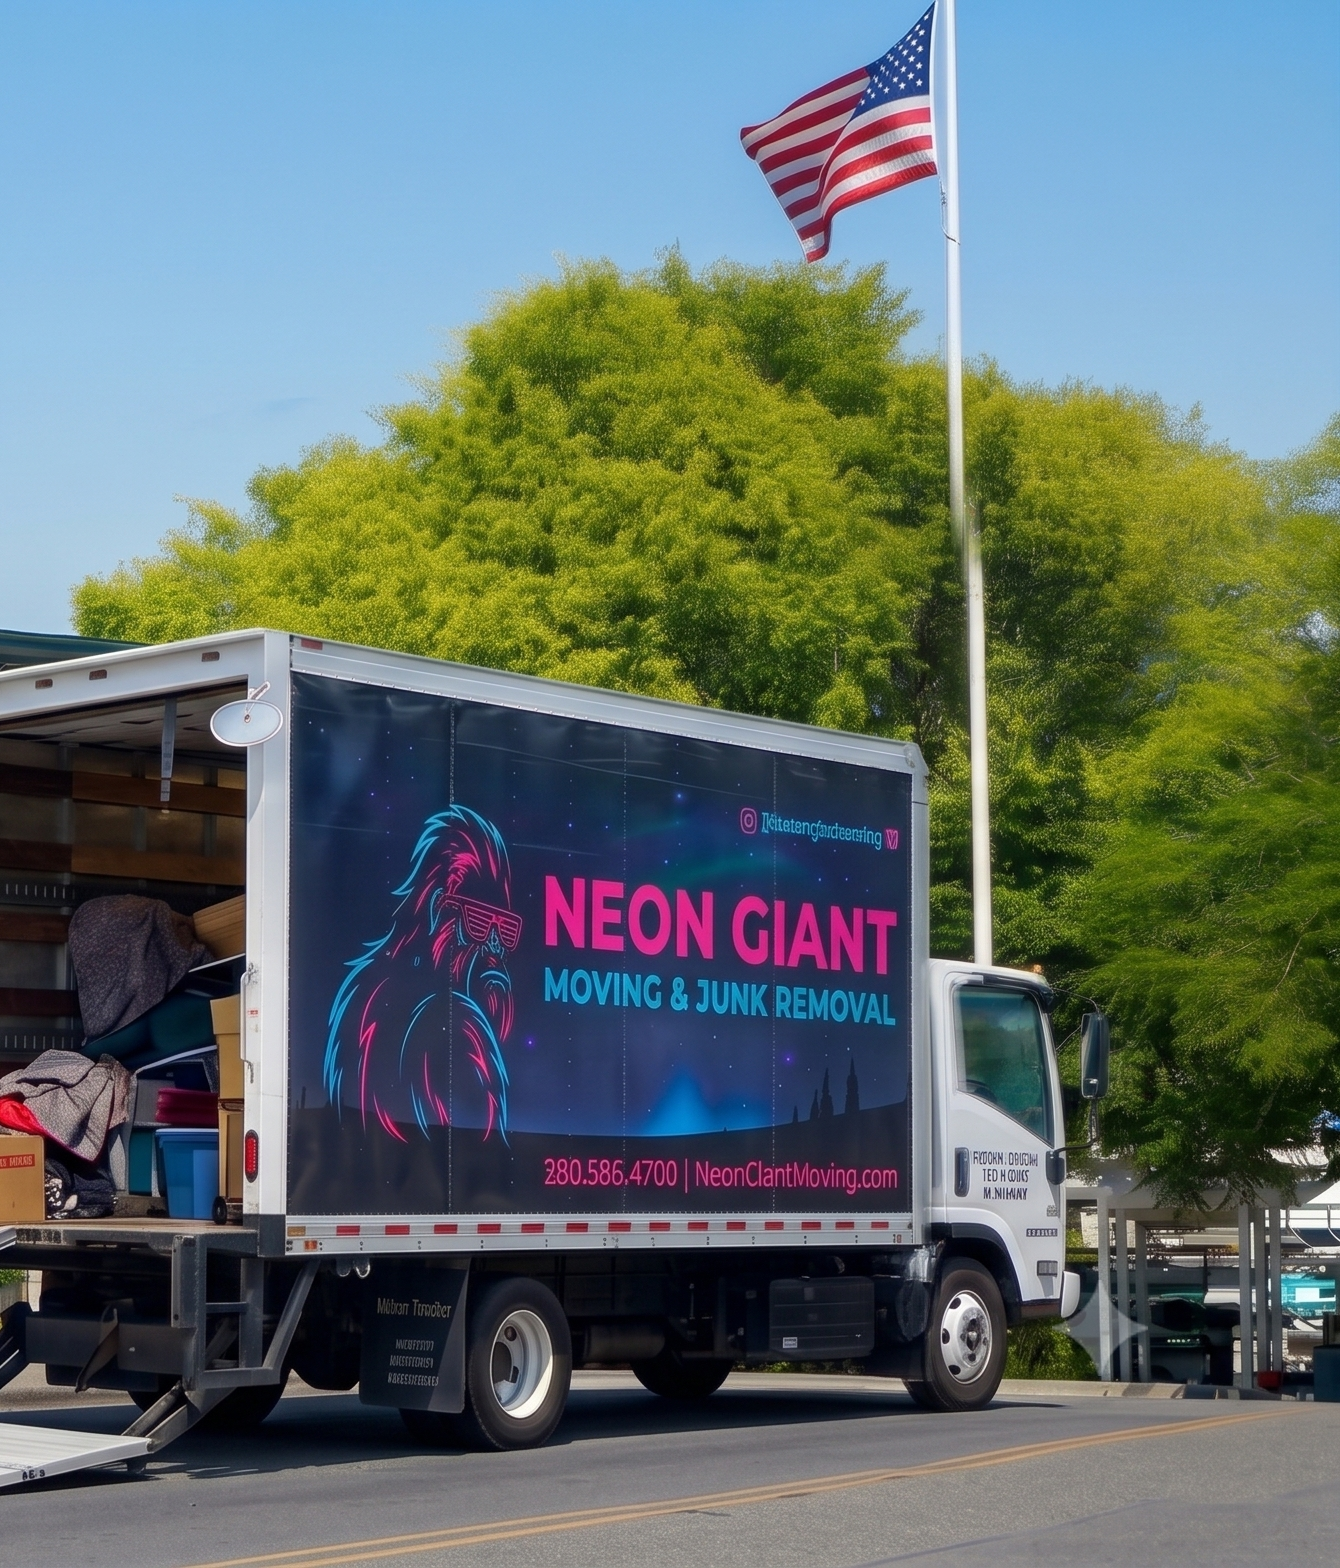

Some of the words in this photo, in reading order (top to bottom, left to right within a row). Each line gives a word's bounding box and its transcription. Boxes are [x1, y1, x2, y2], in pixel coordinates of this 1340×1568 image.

[546, 876, 713, 960] NEON
[732, 896, 897, 975] GIANT
[545, 967, 661, 1009] MOVING
[670, 977, 689, 1012] &
[696, 979, 768, 1017] JUNK
[776, 986, 896, 1026] REMOVAL
[544, 1158, 678, 1187] 280.586.4700
